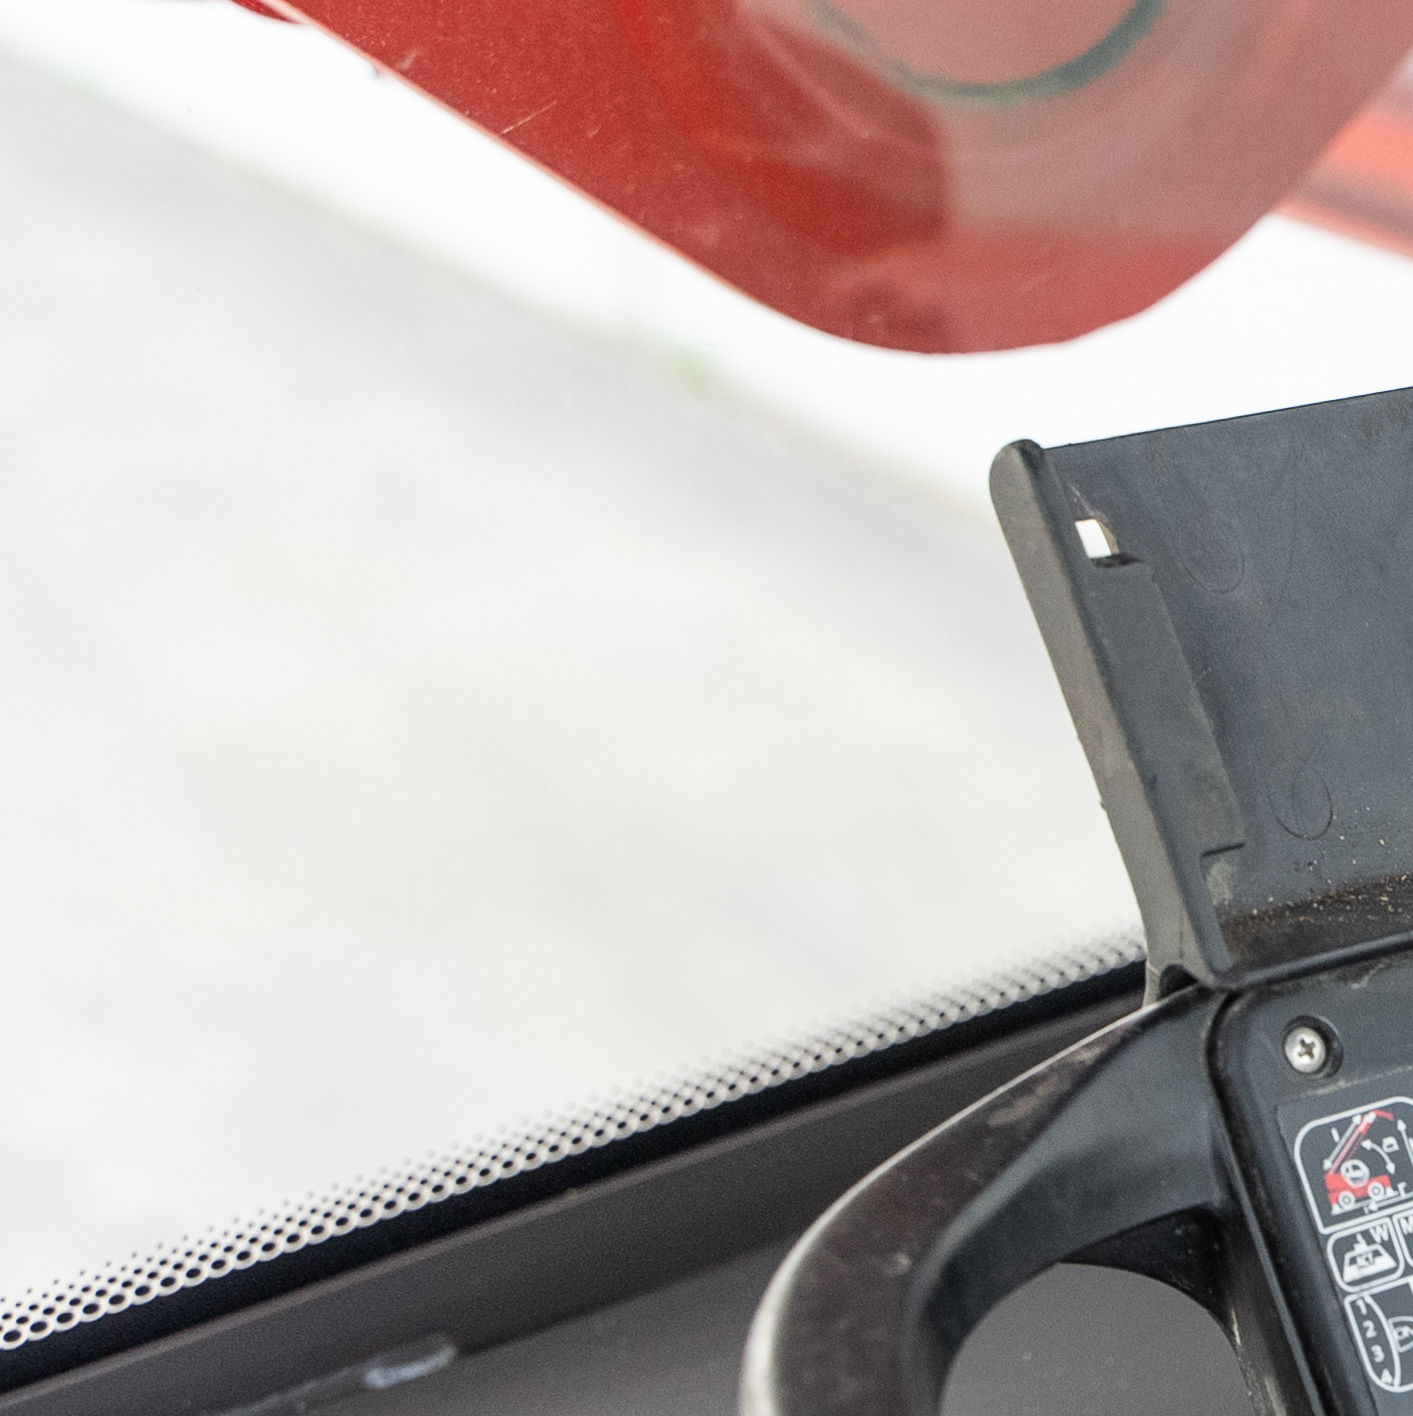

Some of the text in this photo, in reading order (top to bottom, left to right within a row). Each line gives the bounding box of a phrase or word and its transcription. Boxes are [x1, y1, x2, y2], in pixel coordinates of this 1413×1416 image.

[1369, 1223, 1389, 1243] W
[1356, 1298, 1368, 1315] 1
[1363, 1320, 1377, 1338] 2
[1371, 1345, 1385, 1362] 3
